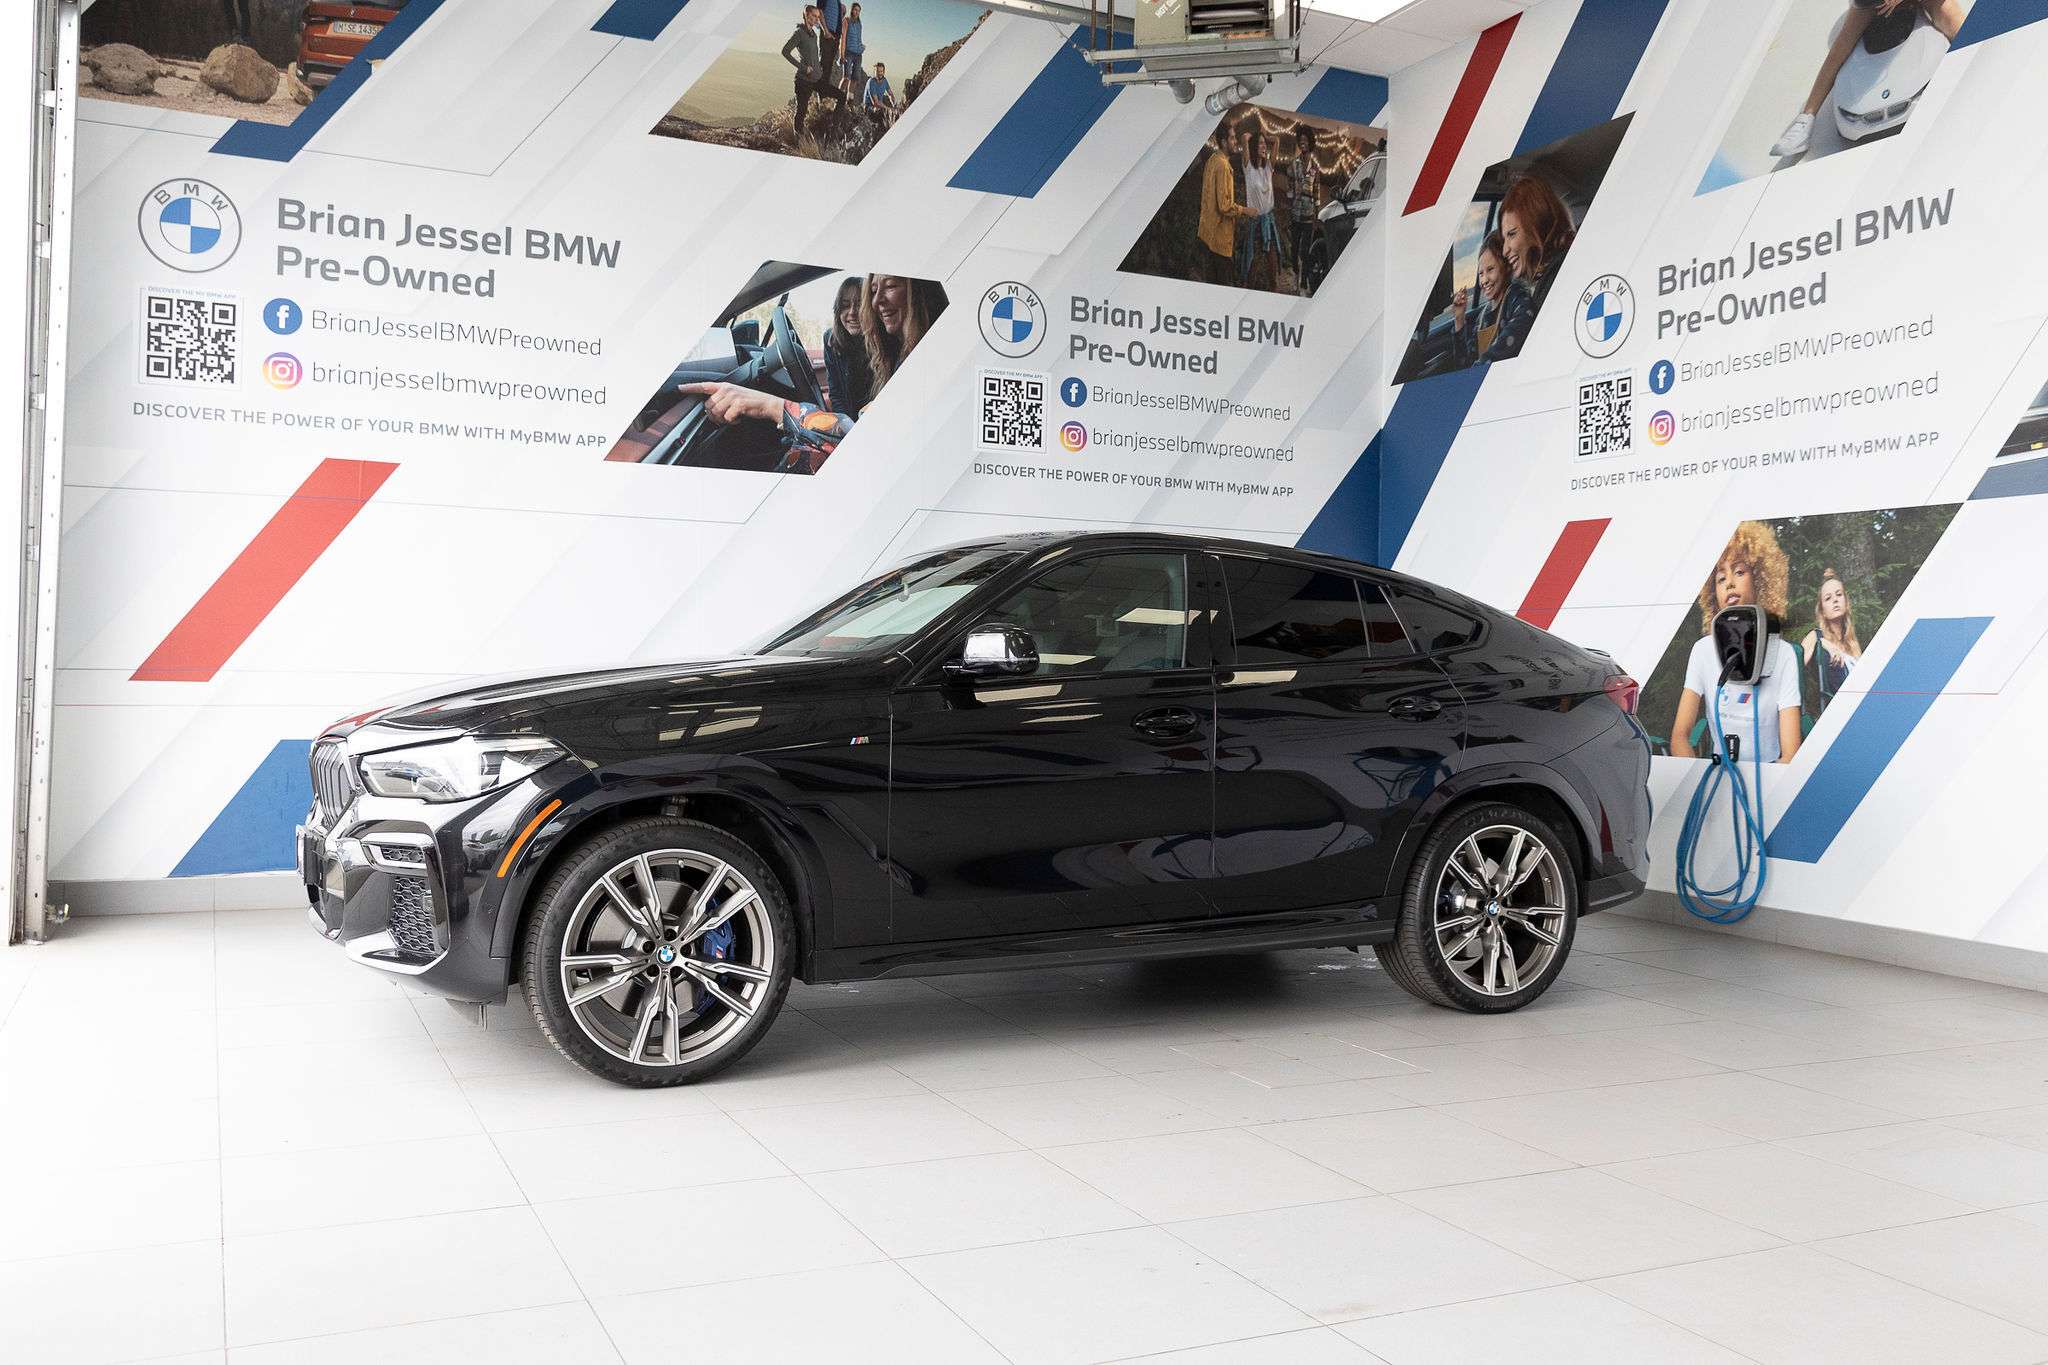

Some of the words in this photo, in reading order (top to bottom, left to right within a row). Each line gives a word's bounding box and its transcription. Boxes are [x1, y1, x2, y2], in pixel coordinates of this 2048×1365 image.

[154, 183, 229, 211] BMW
[278, 198, 384, 240] Brian
[396, 214, 512, 255] Jessel
[526, 229, 621, 268] BMW
[1659, 257, 1734, 296] Brian
[1743, 218, 1842, 279] Jessel
[1856, 188, 1954, 246] BMW
[277, 245, 494, 297] Pre-Owned
[1583, 279, 1627, 306] BMW
[988, 285, 1038, 308] BMW
[1658, 272, 1826, 339] Pre-Owned
[313, 310, 601, 355] BrianJesselBMWPreowned
[1071, 296, 1143, 329] Brian
[1150, 306, 1229, 339] Jessel
[1239, 317, 1304, 348] BMW
[1070, 334, 1217, 374] Pre-Owned
[1682, 315, 1932, 381] BrianJesselBMWPreowned
[313, 362, 605, 404] brianjesselbmwpreowned
[1093, 386, 1290, 421] BrianJesselBMWPreowned
[1682, 371, 1938, 432] brianjesselbmwpreowned
[134, 402, 225, 421] DISCOVER
[231, 410, 265, 424] THE
[273, 413, 335, 429] POWER
[342, 418, 362, 430] OF
[368, 419, 413, 433] YOUR
[420, 423, 459, 436] BMW
[464, 426, 504, 440] WITH
[511, 429, 571, 447] MyBMW
[576, 435, 608, 450] APP
[1093, 428, 1293, 461] brianjesselbmwpreowned
[974, 463, 1035, 478] DISCOVER
[1039, 468, 1062, 479] THE
[1066, 471, 1108, 483] POWER
[1112, 473, 1127, 484] OF
[1130, 475, 1161, 487] YOUR
[1165, 478, 1192, 489] BMW
[1196, 480, 1223, 492] WITH
[1228, 483, 1269, 495] MyBMW
[1272, 487, 1293, 496] APP
[1572, 473, 1625, 490] DISCOVER
[1628, 470, 1651, 482] THE
[1655, 463, 1697, 478] POWER
[1702, 460, 1718, 473] OF
[1722, 455, 1757, 470] YOUR
[1762, 450, 1795, 466] BMW
[1800, 445, 1836, 461] WITH
[1842, 437, 1901, 457] MyBMW
[1906, 432, 1939, 448] APP
